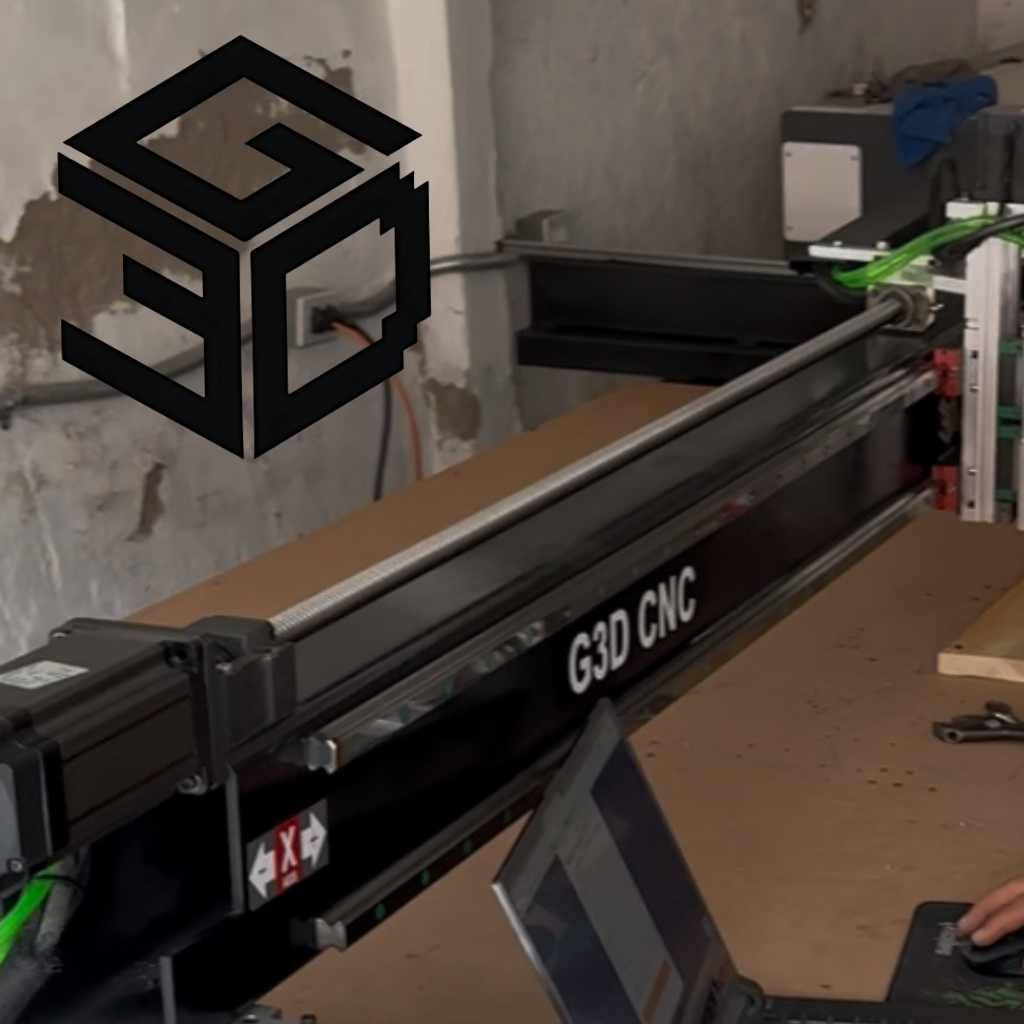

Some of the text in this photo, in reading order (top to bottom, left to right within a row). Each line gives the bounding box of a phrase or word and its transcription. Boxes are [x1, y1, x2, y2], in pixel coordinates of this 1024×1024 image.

[568, 564, 697, 695] G3D CNC
[279, 825, 299, 874] X
